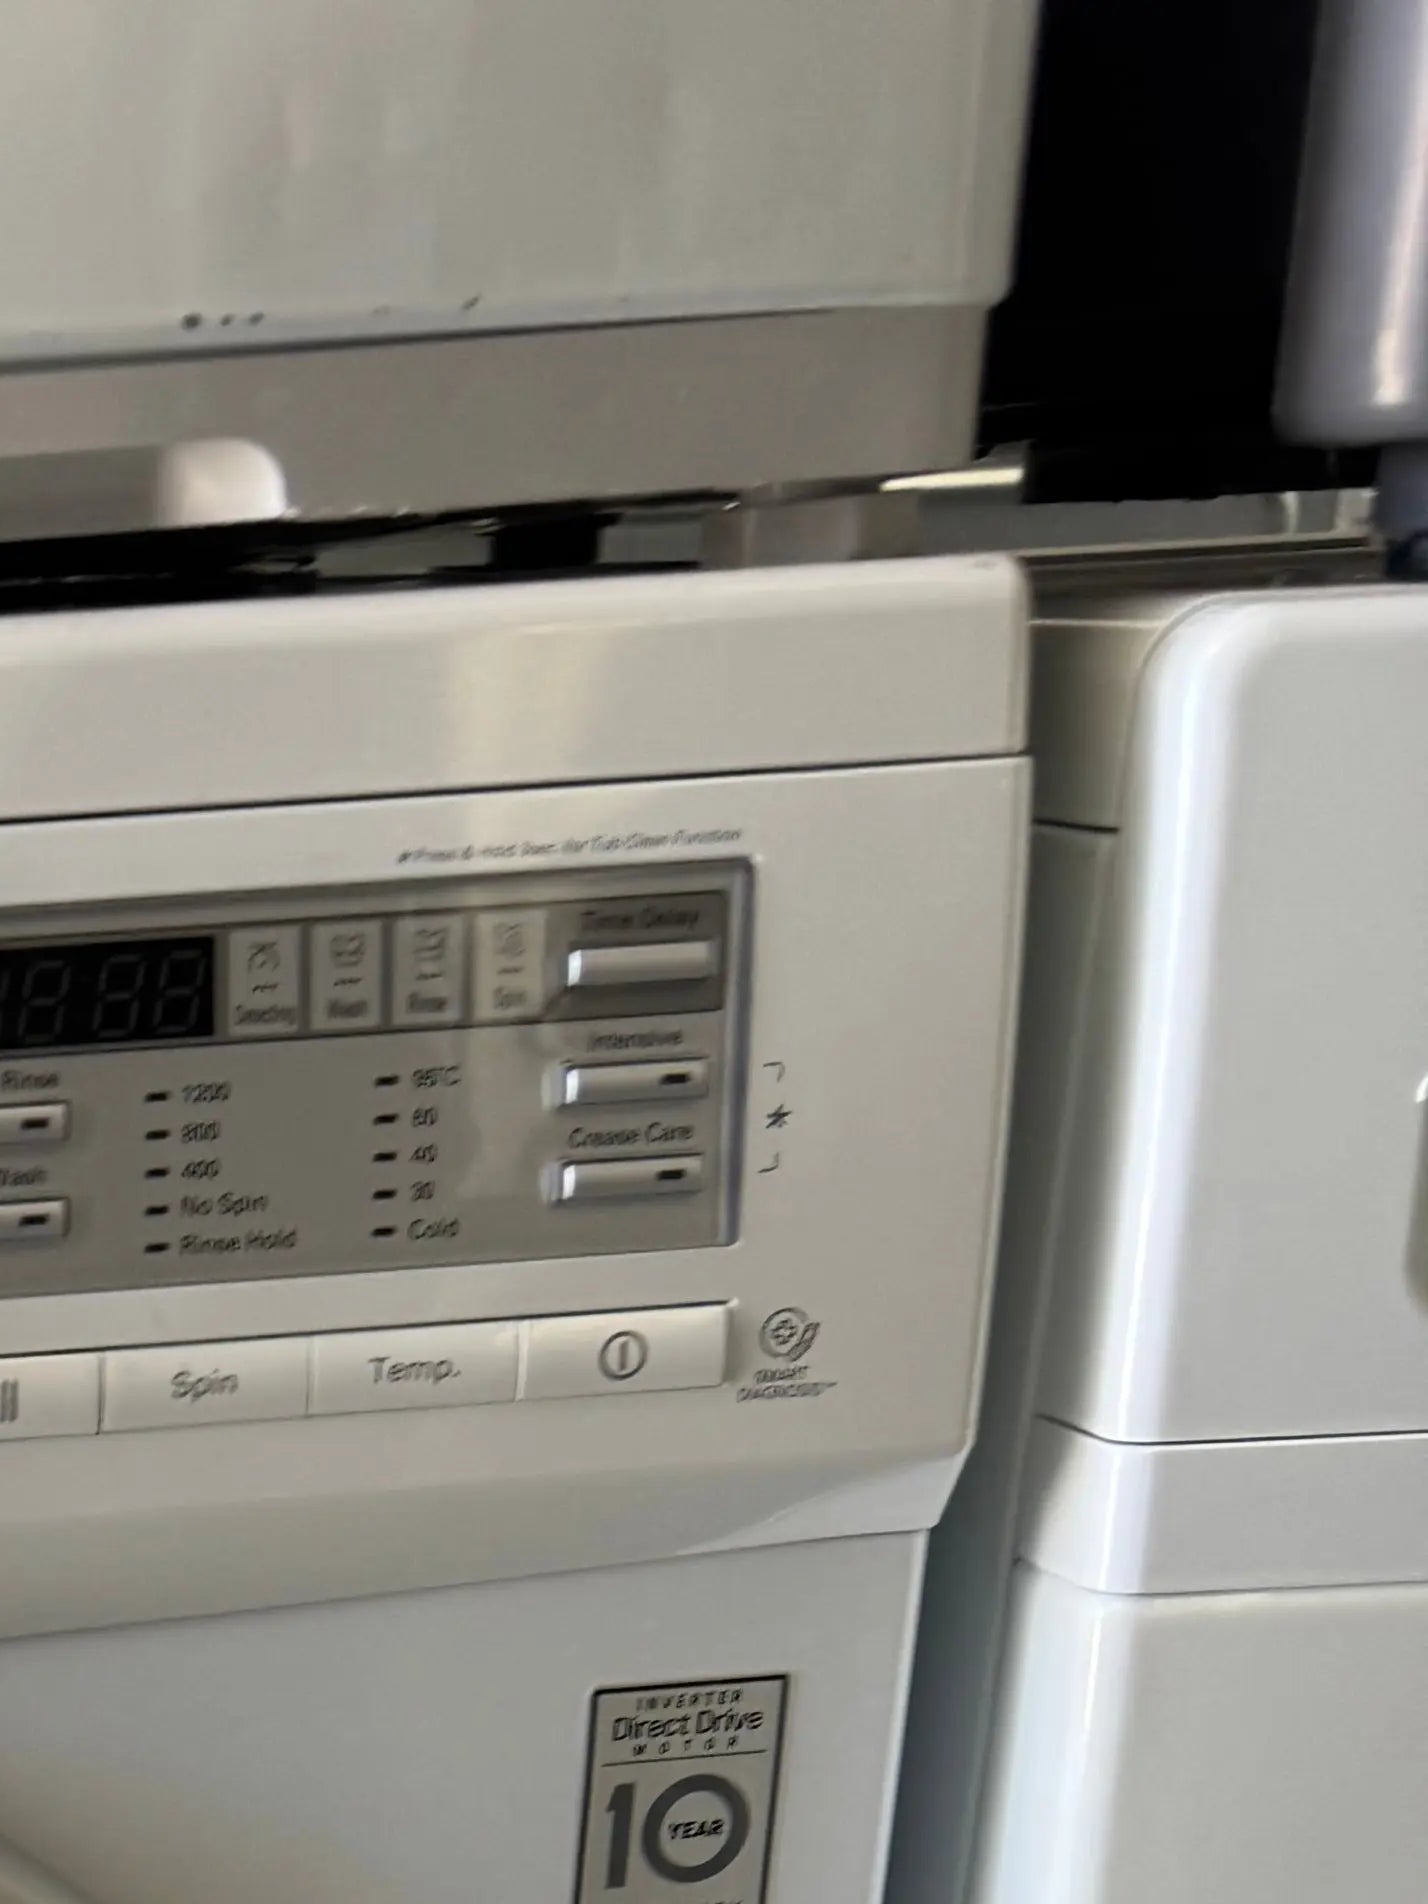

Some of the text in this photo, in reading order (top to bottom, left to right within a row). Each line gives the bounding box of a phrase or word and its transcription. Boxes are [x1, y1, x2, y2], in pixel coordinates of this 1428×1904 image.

[644, 1122, 695, 1144] Care
[180, 1191, 269, 1218] No Spin
[367, 1355, 463, 1387] Temp.
[170, 1368, 240, 1404] Spin
[635, 1688, 745, 1712] INVERTER
[612, 1709, 765, 1743] Direct Drive
[632, 1736, 739, 1758] MOTOR
[604, 1772, 753, 1891] 10
[667, 1818, 725, 1841] YEAR
